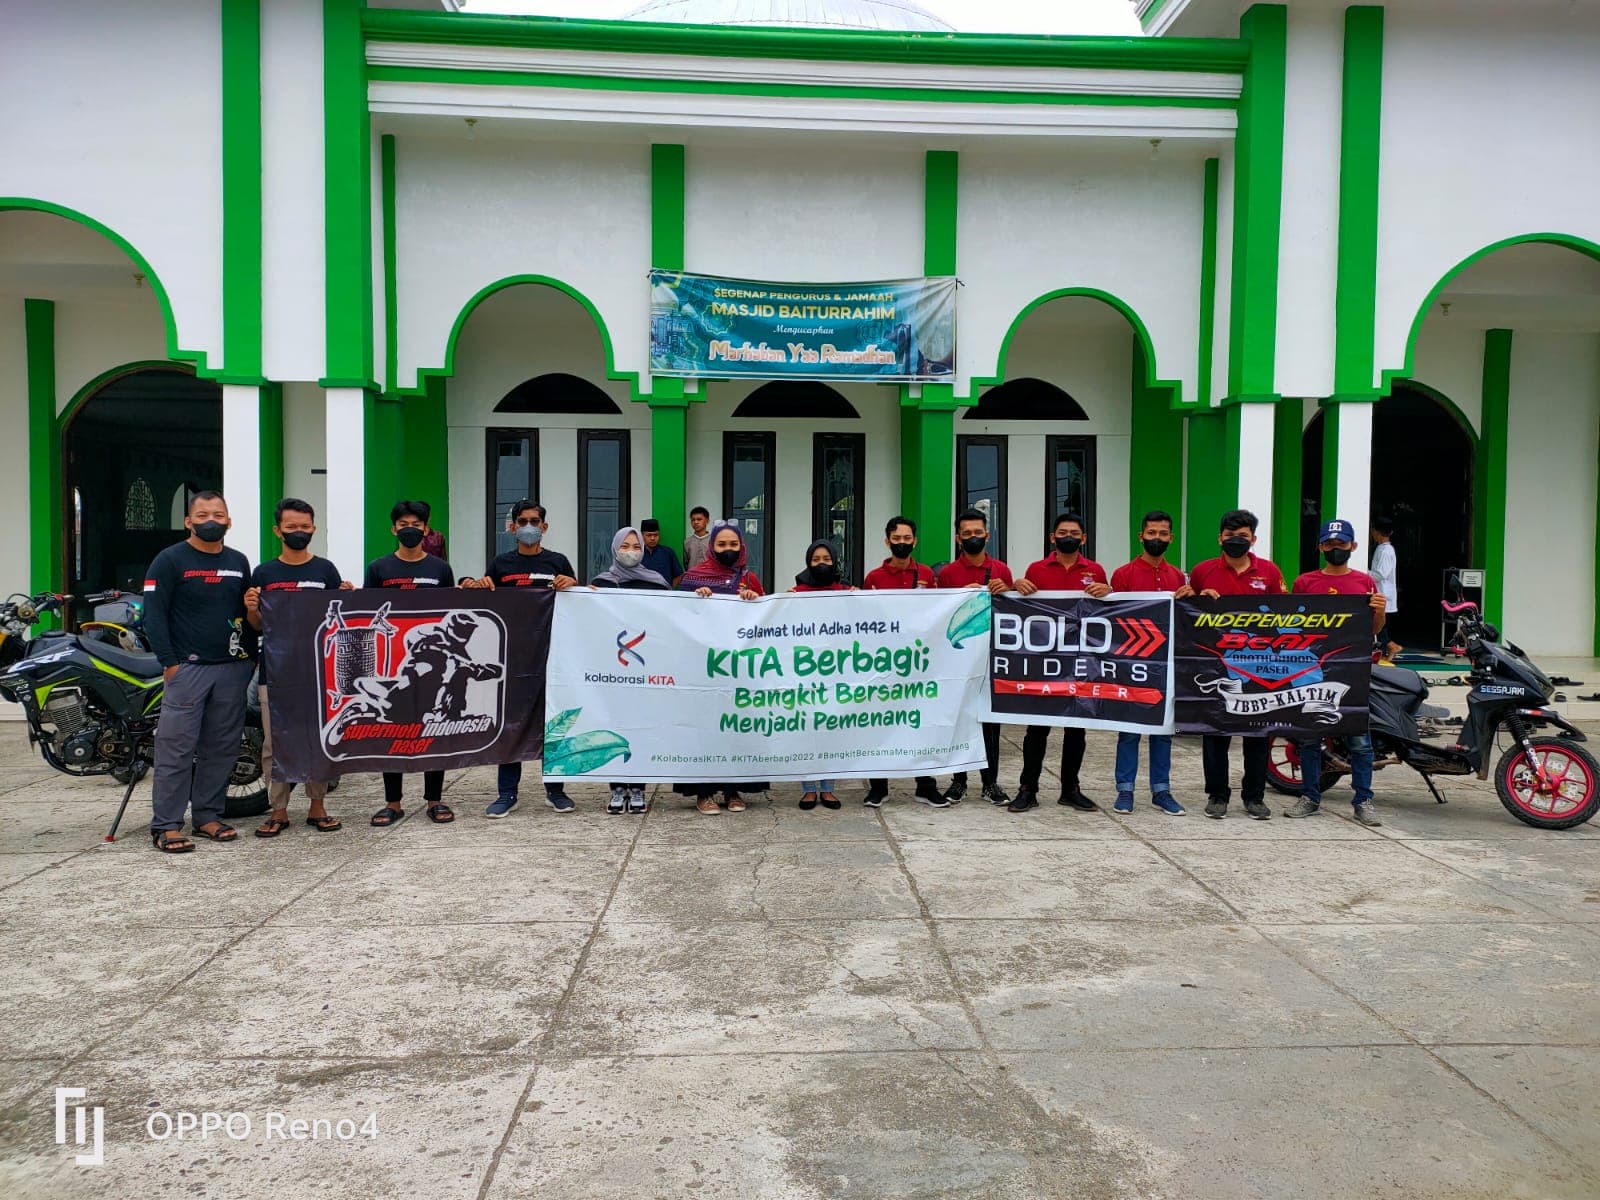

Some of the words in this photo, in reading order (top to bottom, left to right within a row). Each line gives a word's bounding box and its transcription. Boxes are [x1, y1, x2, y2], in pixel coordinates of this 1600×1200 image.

[714, 287, 768, 299] SEGENAP
[769, 290, 831, 301] PENGURUS
[834, 290, 841, 301] &
[844, 292, 895, 303] JAMAAH
[711, 302, 775, 318] MASJID
[779, 304, 896, 321] BAITURRAHIM
[709, 340, 786, 363] Marhaban
[787, 343, 823, 364] Yaa
[821, 343, 897, 364] Ramadhan
[737, 625, 787, 639] Selamat
[792, 622, 815, 636] Idul
[819, 621, 851, 635] Adha
[855, 621, 887, 634] 1442
[891, 621, 900, 633] H
[1194, 613, 1352, 628] INDEPENDENT
[994, 613, 1112, 654] BOLD
[706, 646, 784, 679] KITA
[793, 638, 930, 678] Berbagi;
[994, 656, 1147, 682] RIDERS
[1256, 665, 1289, 674] PASER
[584, 672, 645, 684] kolaborasi
[648, 675, 676, 686] KITA
[734, 682, 829, 710] Bangkit
[835, 680, 939, 705] Bersama
[1016, 683, 1128, 698] PASER
[1233, 687, 1338, 713] IBBP-KALTIM
[343, 722, 423, 741] supermoto
[420, 715, 493, 738] indonesia
[719, 710, 807, 737] Menjadi
[813, 708, 921, 731] Pemenang
[388, 737, 434, 755] paser
[650, 754, 728, 764] #KolaborasiKITA
[731, 752, 815, 763] #KITAberbagi2022
